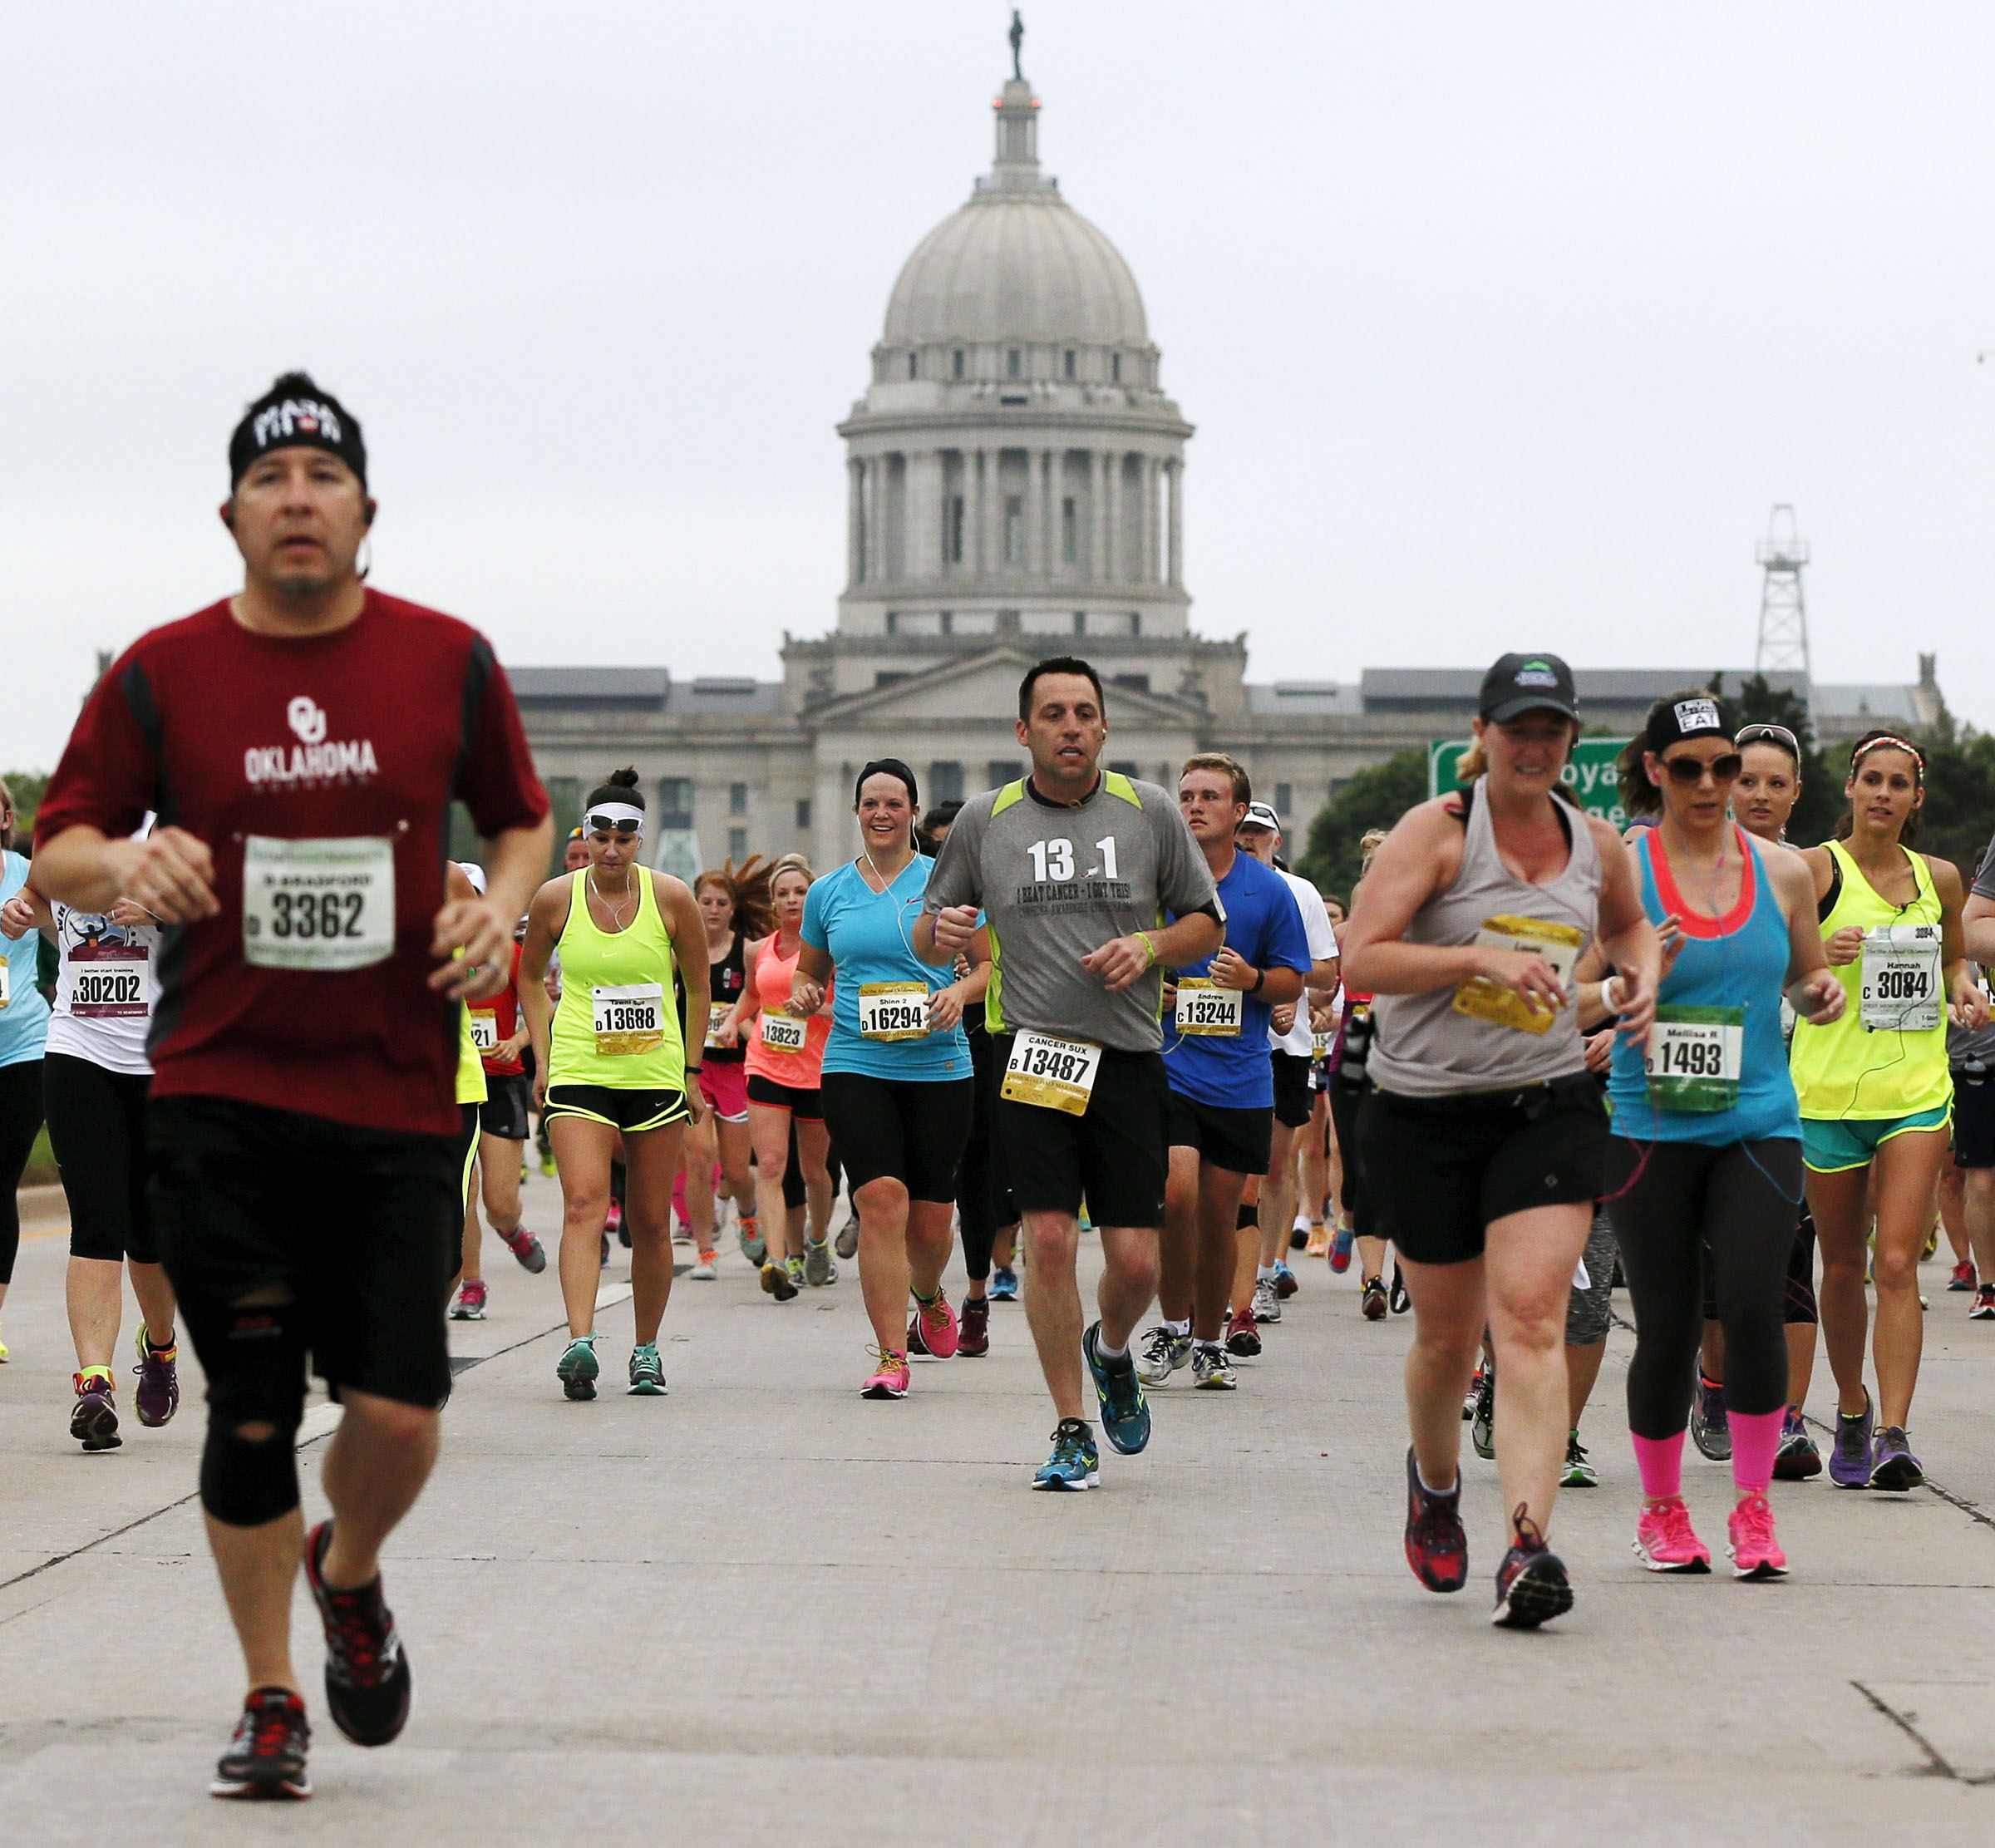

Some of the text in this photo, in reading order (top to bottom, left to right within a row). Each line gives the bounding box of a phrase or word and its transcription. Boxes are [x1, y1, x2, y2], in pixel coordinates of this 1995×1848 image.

[244, 739, 379, 783] OKLAHOMA
[1022, 886, 1044, 903] BEAT
[1047, 884, 1079, 900] CANCER
[1093, 883, 1108, 899] GOT
[273, 893, 364, 938] 3362
[72, 976, 140, 1002] A 30202
[1863, 971, 1927, 999] C 3084
[596, 1007, 655, 1032] D 13688
[862, 1007, 922, 1031] D 16294
[1177, 1002, 1235, 1024] C 13244
[766, 1025, 800, 1045] 13823
[1028, 1037, 1087, 1055] CANCER SUX
[1009, 1047, 1090, 1083] B 13487
[1661, 1042, 1722, 1075] 1493
